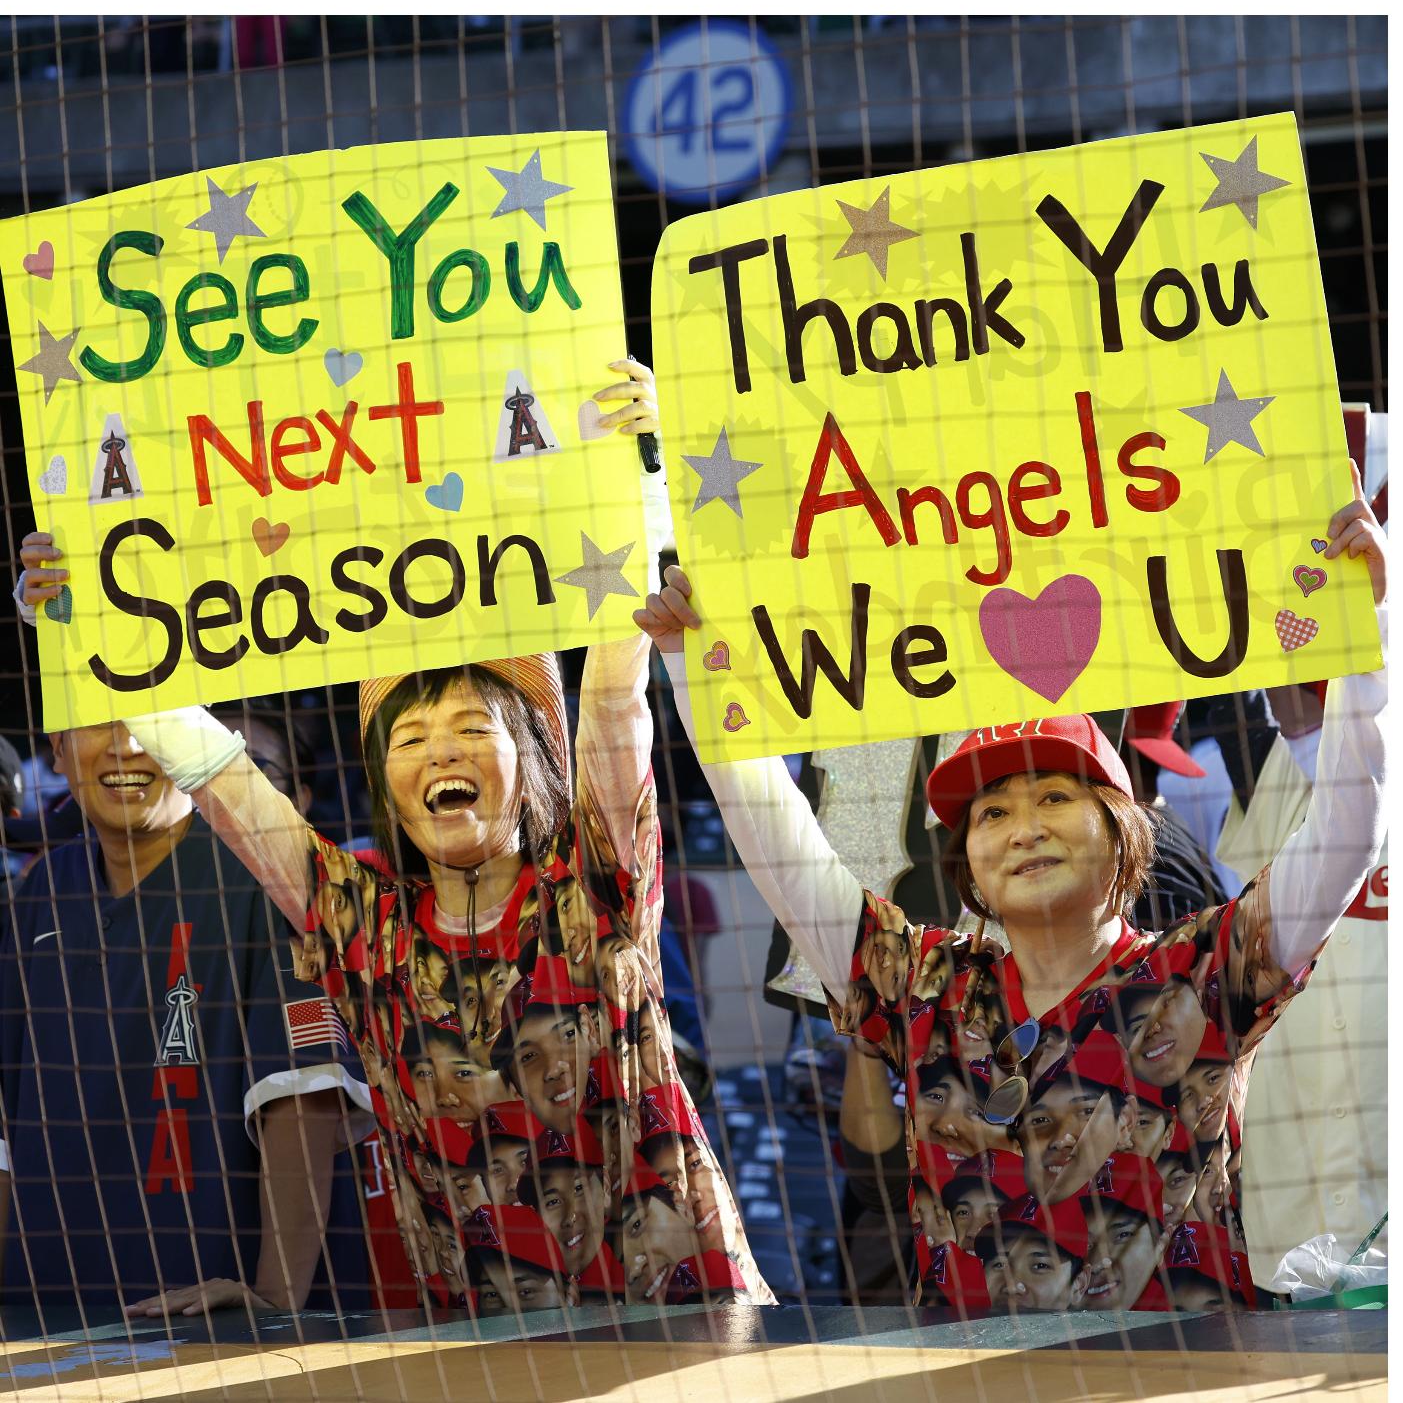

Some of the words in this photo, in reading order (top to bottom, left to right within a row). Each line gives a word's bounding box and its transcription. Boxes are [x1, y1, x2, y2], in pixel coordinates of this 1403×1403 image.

[648, 66, 756, 156] 42
[79, 229, 319, 384] See
[341, 181, 582, 340] You
[688, 231, 1026, 395] Thank
[1035, 179, 1269, 354] You
[187, 361, 445, 507] Next
[790, 390, 1180, 586] Angels
[87, 517, 557, 693] Season
[752, 582, 957, 719] We
[1146, 547, 1251, 679] U
